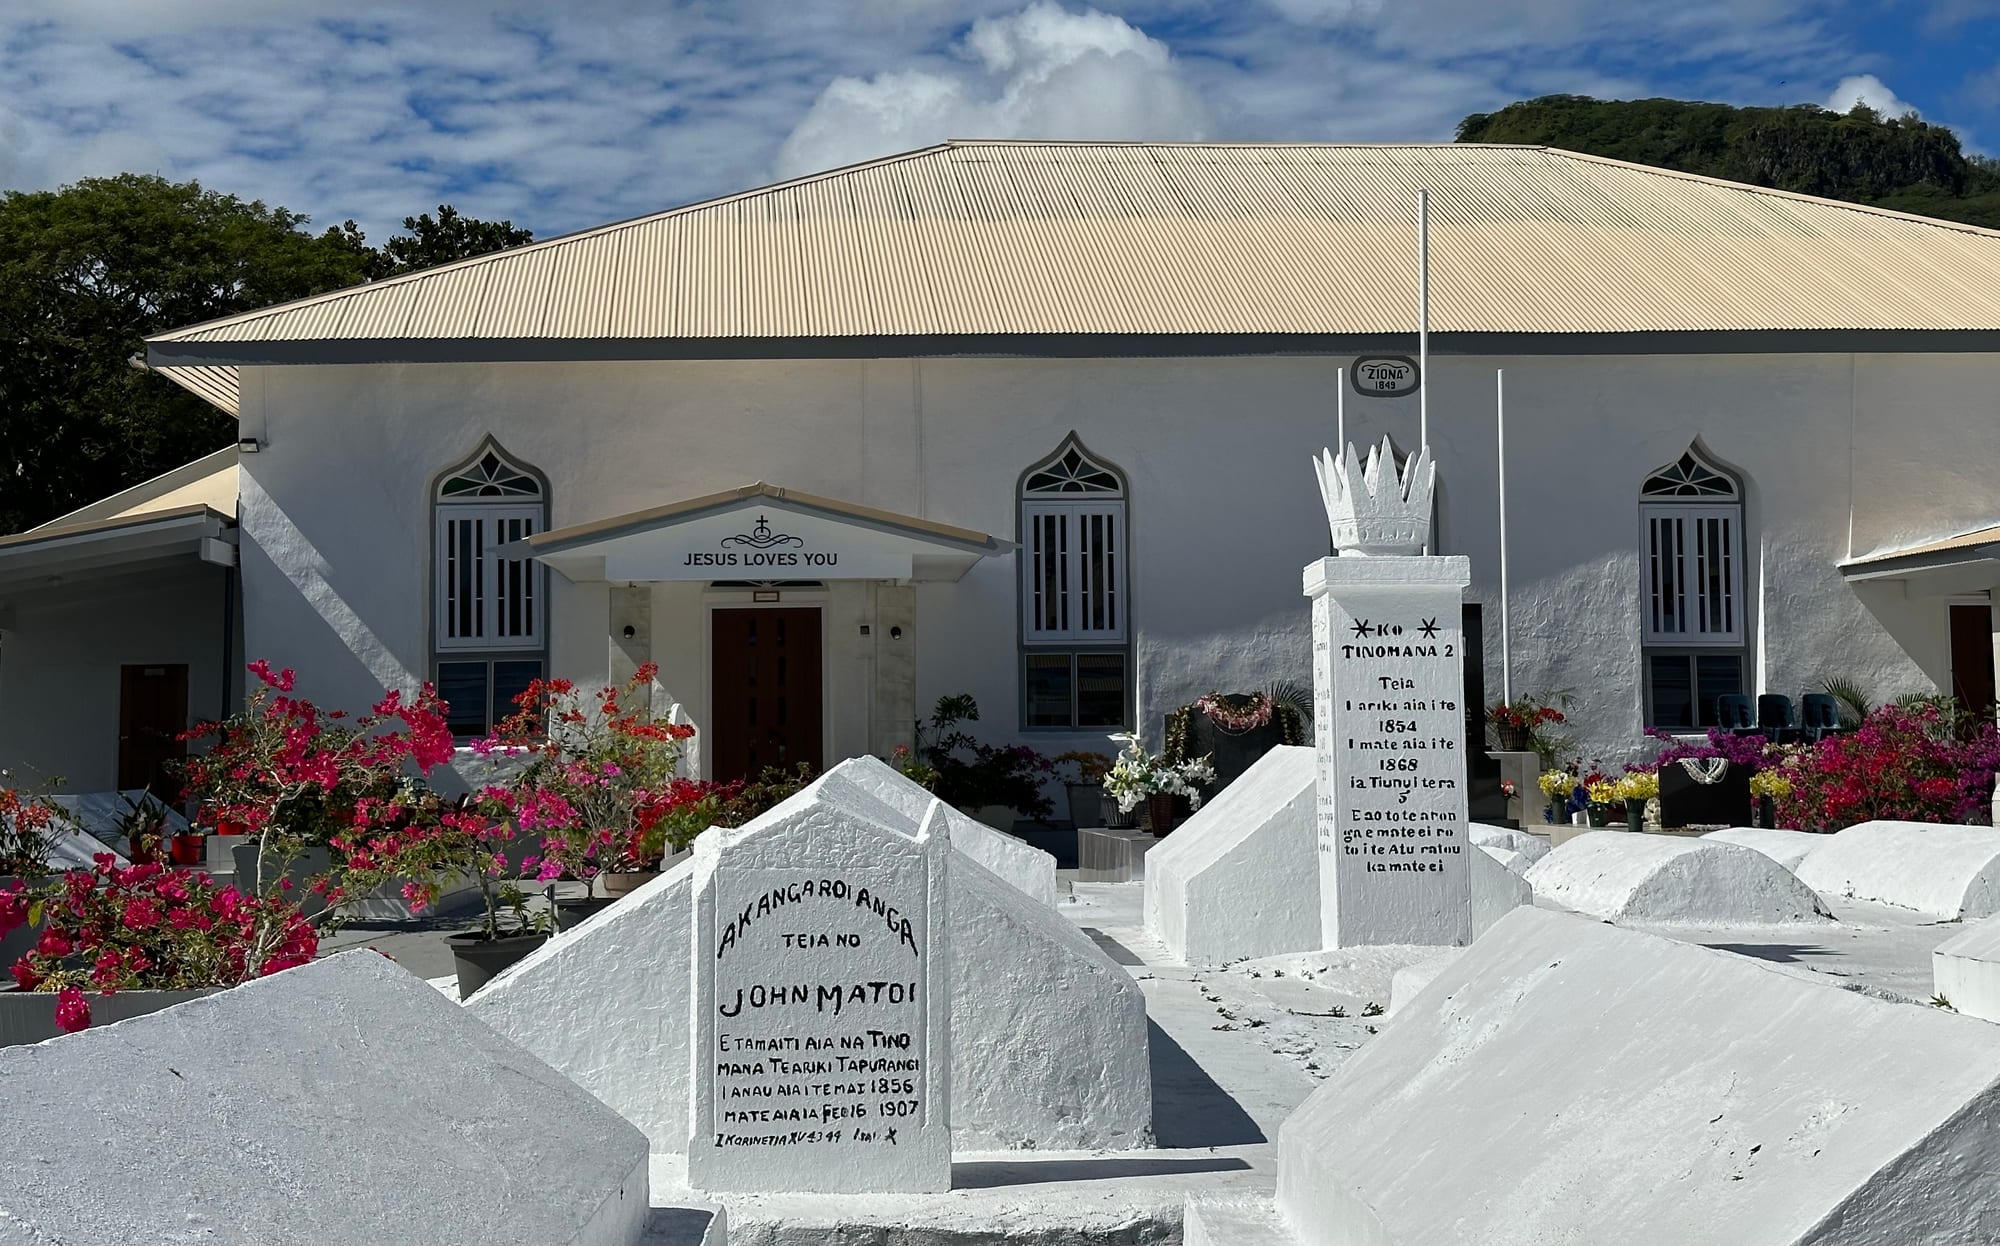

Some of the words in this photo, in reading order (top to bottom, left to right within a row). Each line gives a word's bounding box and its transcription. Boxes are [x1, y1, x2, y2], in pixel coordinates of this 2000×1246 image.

[1368, 368, 1404, 380] ZIONA
[1375, 381, 1396, 390] 1849
[683, 553, 738, 566] JESUS
[744, 553, 798, 566] LOVES
[803, 553, 838, 566] YOU
[1341, 644, 1437, 659] TINOMANA
[1444, 644, 1454, 657] 2
[1378, 677, 1415, 690] Teia
[1359, 700, 1398, 711] ariki
[1403, 699, 1426, 711] aia
[1440, 700, 1456, 711] te
[1379, 719, 1417, 733] 1854
[1360, 738, 1398, 750] mate
[1402, 737, 1427, 750] aia
[1440, 738, 1454, 750] te
[1380, 758, 1418, 772] 1868
[1398, 790, 1411, 804] 5
[1420, 843, 1461, 854] ratou
[782, 933, 829, 948] TEIA
[836, 934, 861, 948] NO
[719, 984, 809, 1017] JOHN
[817, 981, 916, 1016] MATOI
[720, 1034, 730, 1052] E
[805, 1036, 834, 1050] AIA
[840, 1035, 864, 1050] NA
[717, 1062, 764, 1076] MANA
[835, 1056, 920, 1073] TAPURANGI
[731, 1086, 772, 1098] ANAU
[871, 1078, 914, 1095] 1856
[724, 1110, 769, 1123] MATE
[850, 1103, 867, 1118] 16
[879, 1100, 919, 1117] 1907
